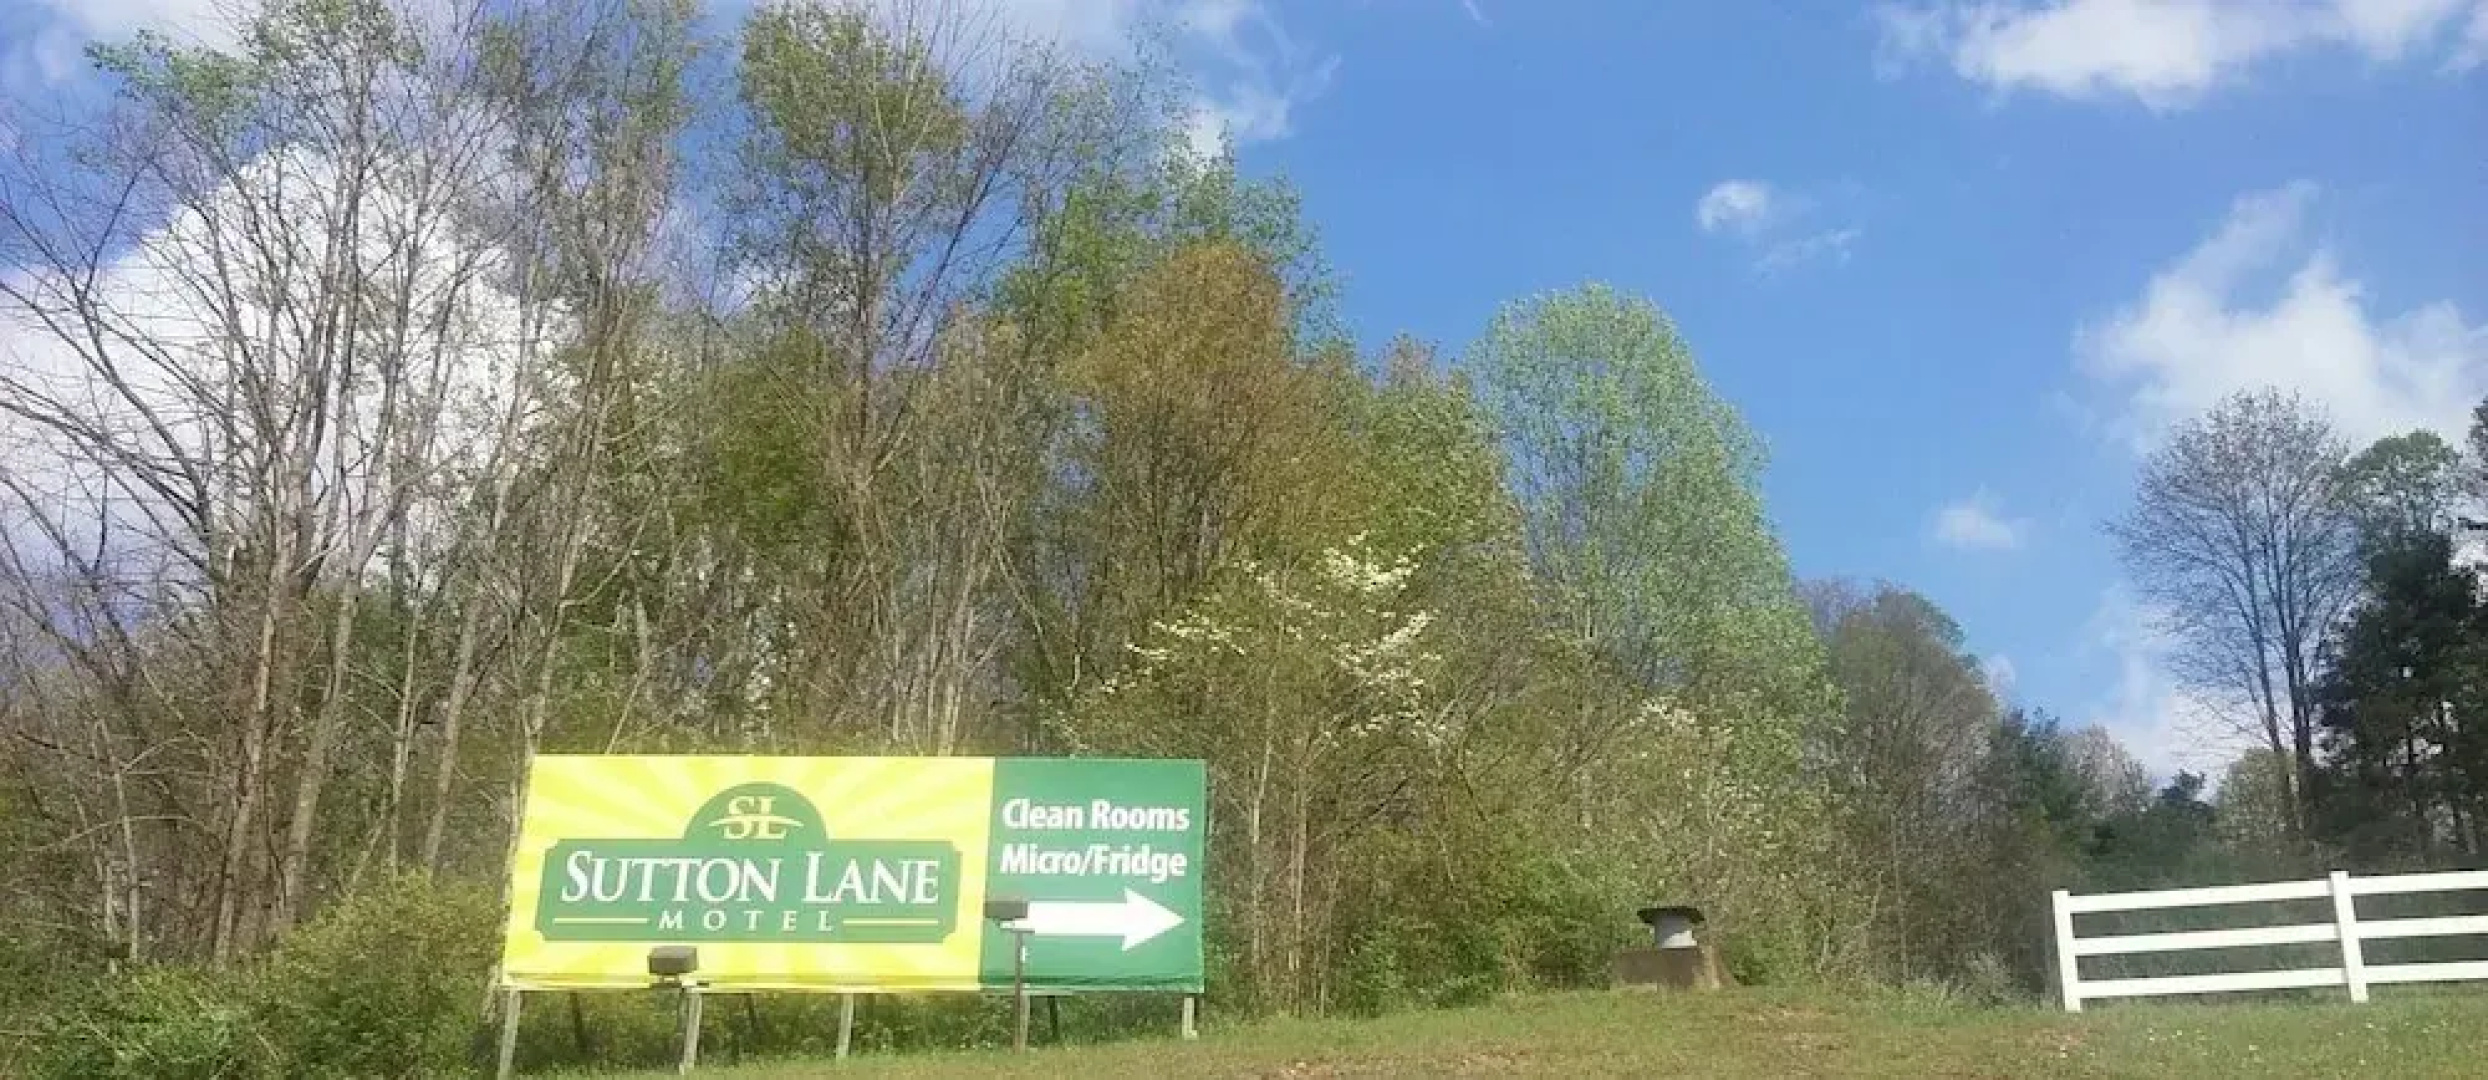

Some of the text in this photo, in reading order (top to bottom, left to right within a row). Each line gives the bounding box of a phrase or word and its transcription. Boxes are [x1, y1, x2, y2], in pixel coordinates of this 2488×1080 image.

[722, 796, 787, 839] SL
[1002, 798, 1190, 831] Clean Rooms
[561, 850, 940, 904] SUTTON LANE
[1000, 843, 1187, 883] Micro/Fridge
[658, 910, 834, 932] MOTEL
